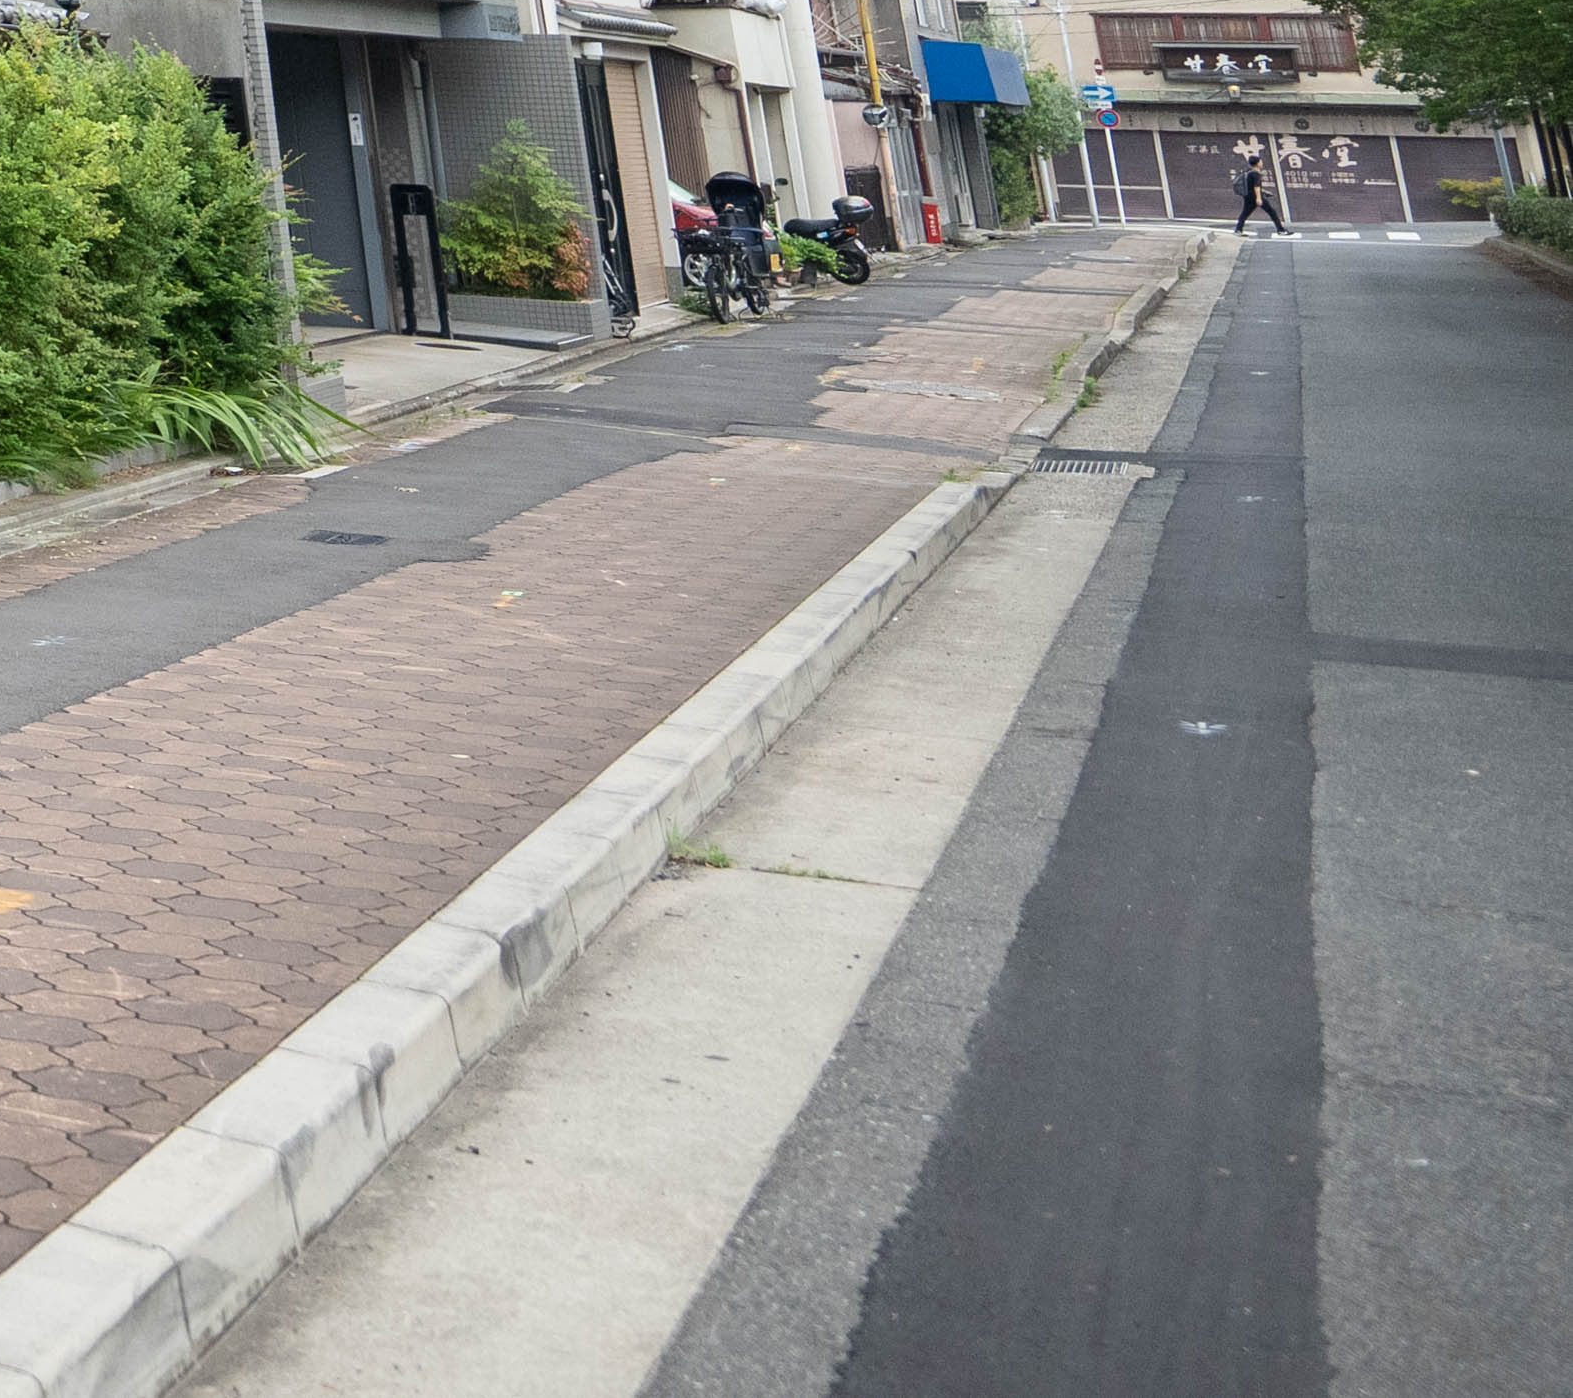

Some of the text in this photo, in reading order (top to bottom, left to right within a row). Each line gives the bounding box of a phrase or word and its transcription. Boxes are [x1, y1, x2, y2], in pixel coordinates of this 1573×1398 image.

[1183, 53, 1273, 75] 甘春堂
[1232, 133, 1360, 168] 甘春堂
